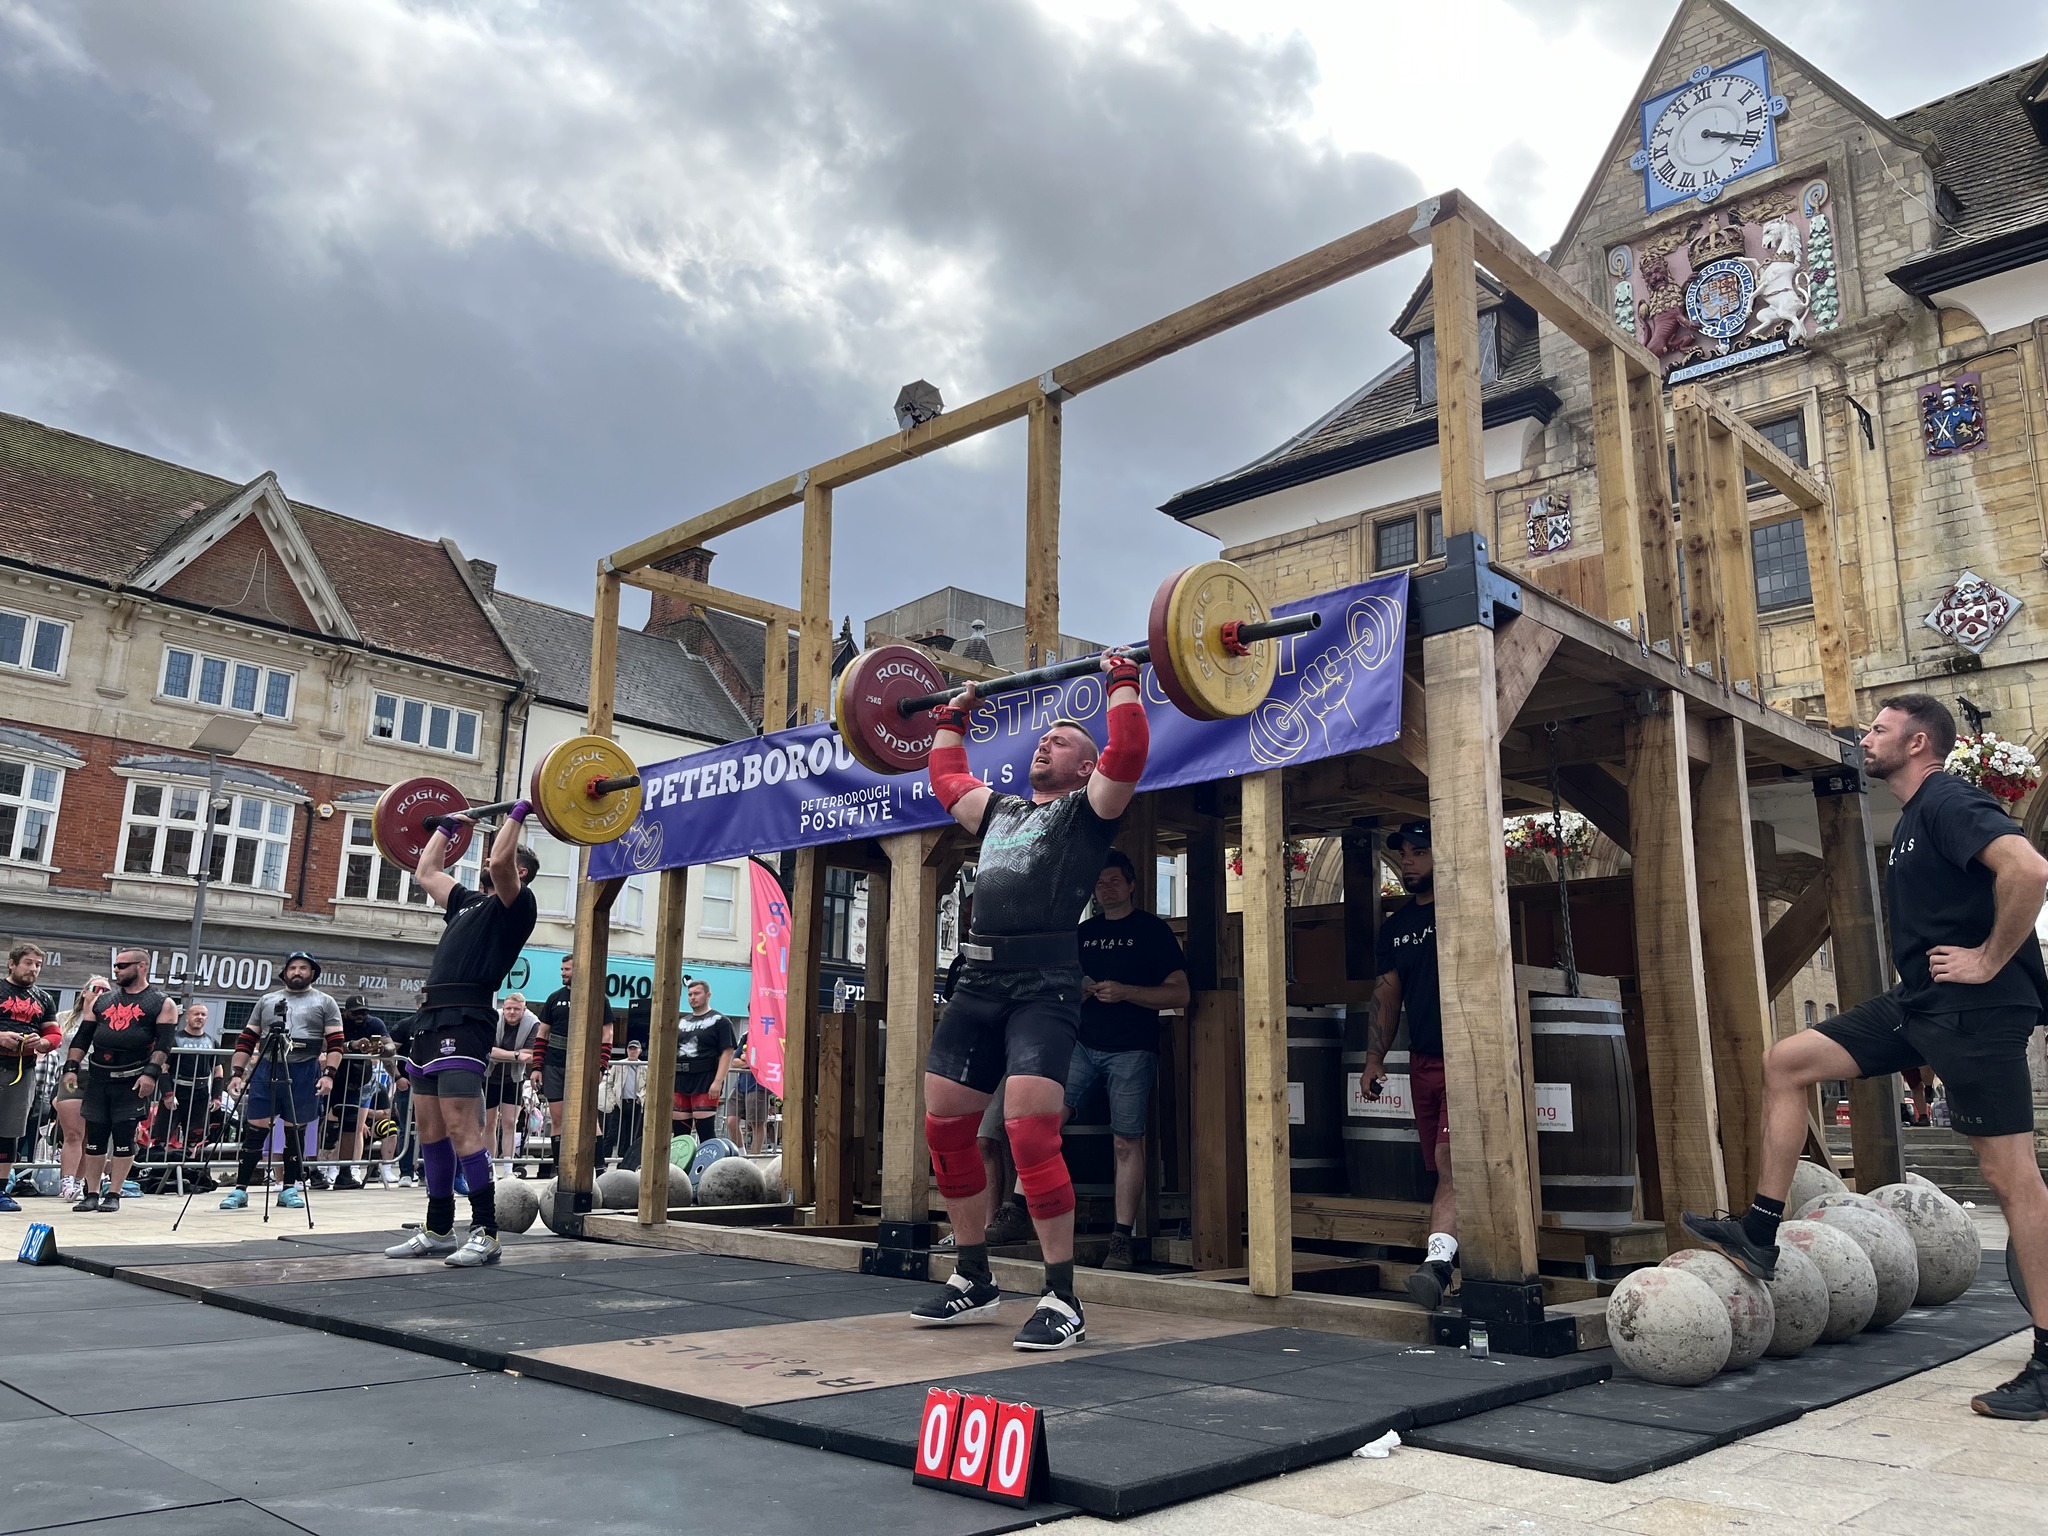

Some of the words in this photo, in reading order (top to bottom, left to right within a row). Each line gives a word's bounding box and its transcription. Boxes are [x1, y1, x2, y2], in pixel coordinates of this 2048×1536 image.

[1692, 65, 1710, 79] 60
[1693, 84, 1712, 106] XII
[1737, 89, 1755, 105] II
[1770, 99, 1783, 112] 15
[1672, 101, 1690, 120] XI
[1746, 106, 1763, 124] III
[1657, 126, 1674, 138] X
[1632, 154, 1646, 166] 45
[1653, 142, 1669, 161] IX
[1730, 156, 1744, 170] V
[1677, 171, 1696, 188] VII
[1703, 168, 1720, 185] VI
[1703, 188, 1719, 201] 30
[1191, 583, 1216, 681] ROGUE
[876, 662, 936, 694] ROGUE
[873, 721, 933, 753] ROGUE
[557, 750, 608, 790] ROGUE
[644, 734, 856, 812] PETERBOROU
[397, 788, 451, 815] ROGUE
[801, 783, 890, 813] PETERBOROUGH
[800, 799, 893, 834] POSITIVE
[1083, 938, 1134, 948] ROYALS
[111, 947, 273, 991] LDWOOD
[314, 972, 346, 988] RILLS
[359, 975, 388, 990] PIZZA
[400, 978, 427, 993] PAST
[605, 973, 652, 999] OKO
[21, 1228, 46, 1259] 090
[923, 1403, 1025, 1488] 090
